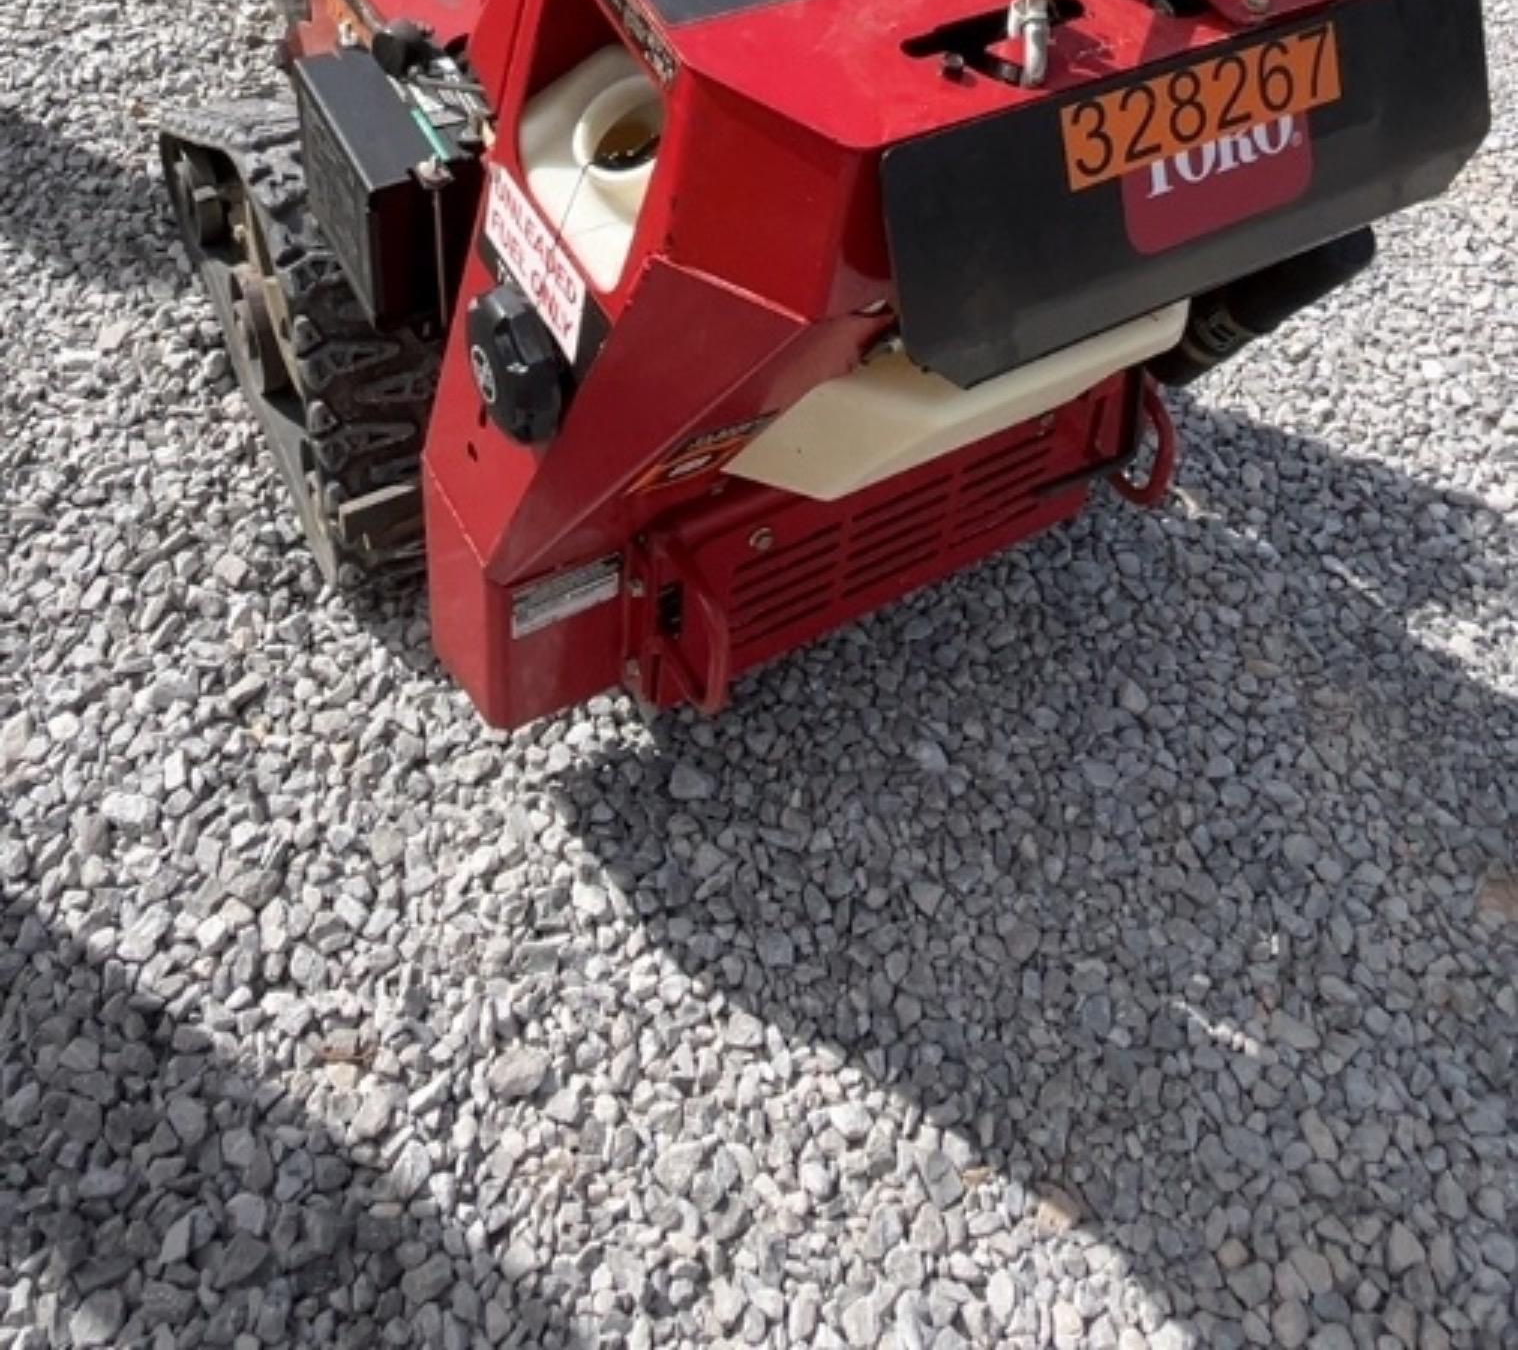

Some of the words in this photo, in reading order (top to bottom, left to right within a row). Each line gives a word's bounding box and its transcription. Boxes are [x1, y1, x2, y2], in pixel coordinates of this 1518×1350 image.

[1070, 27, 1329, 176] 328267
[491, 208, 529, 277] FUEL
[530, 269, 574, 340] ONLY
[494, 168, 577, 305] UNLEADED
